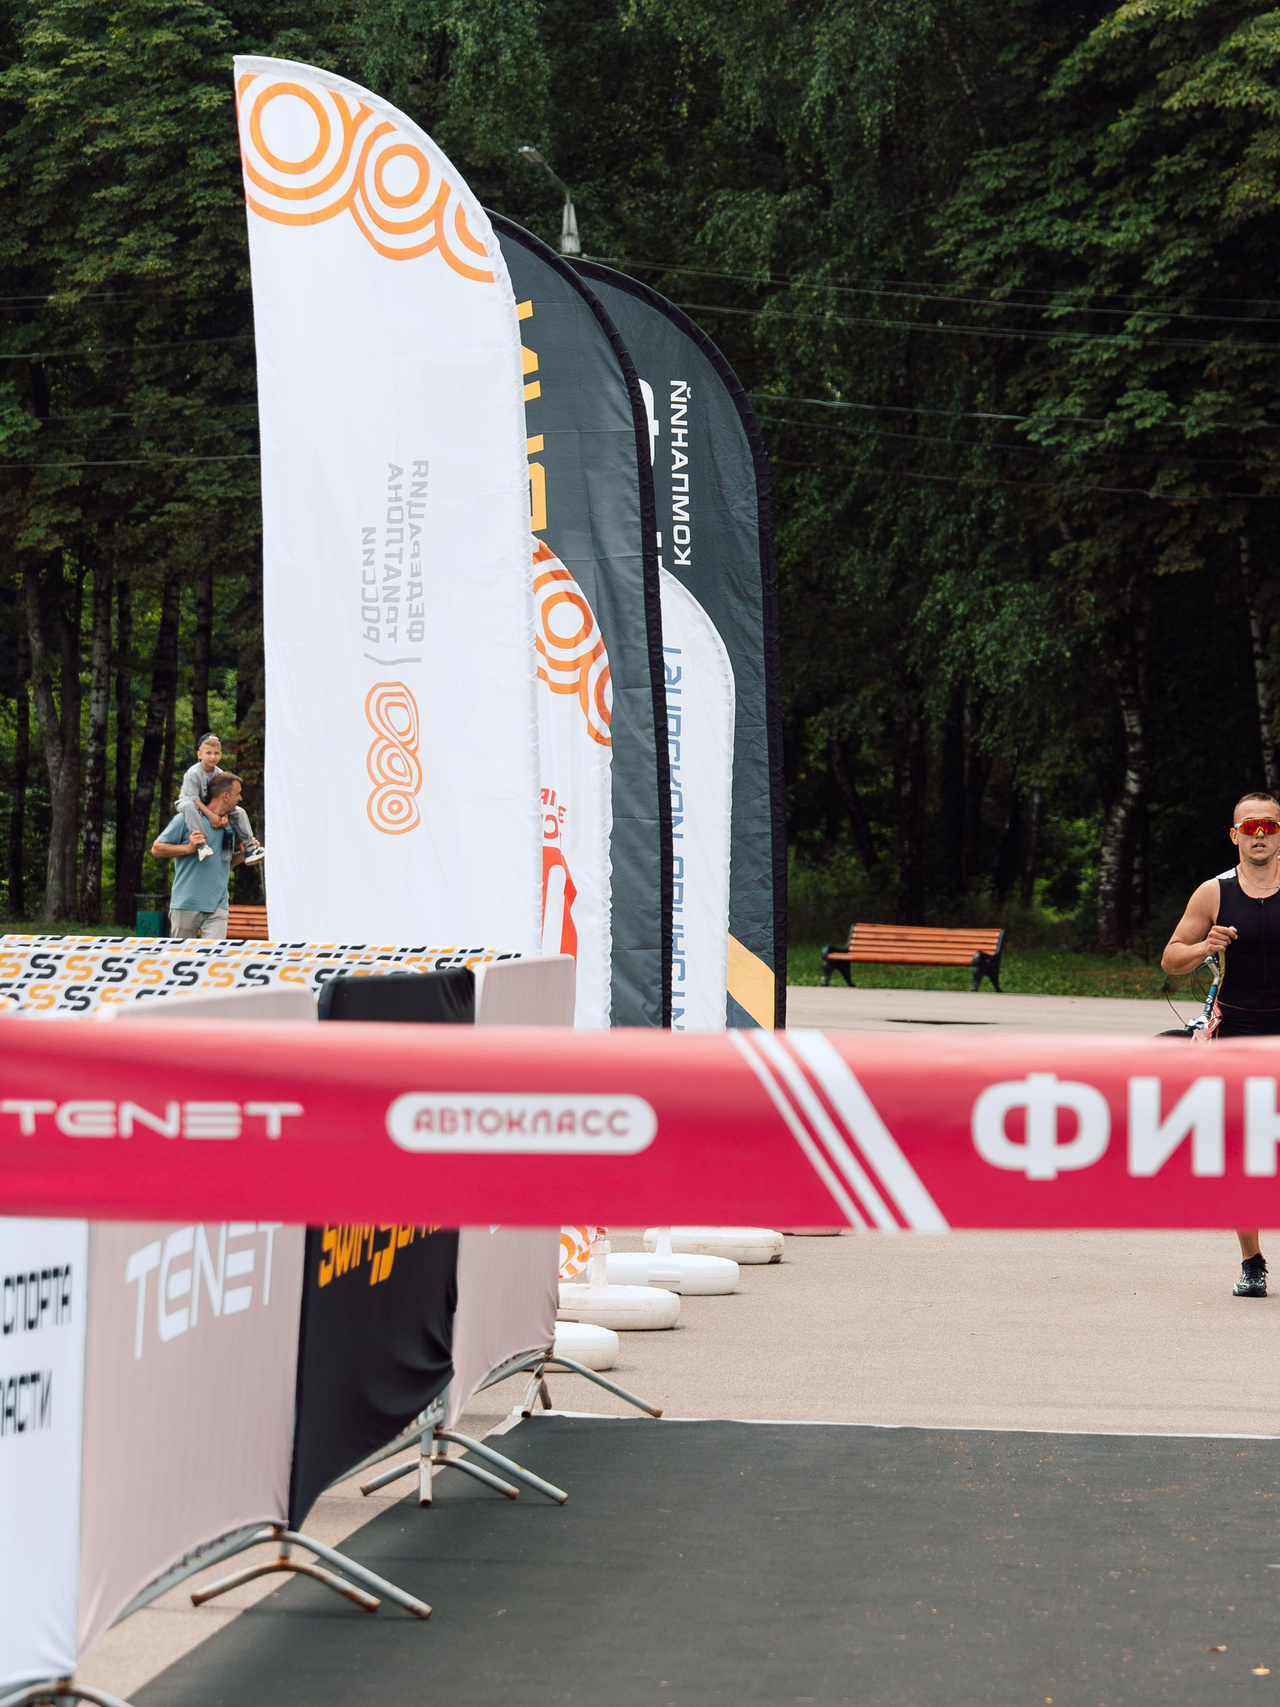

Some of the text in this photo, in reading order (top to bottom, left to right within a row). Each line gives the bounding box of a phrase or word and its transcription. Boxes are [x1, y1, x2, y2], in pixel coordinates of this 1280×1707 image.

[0, 1101, 304, 1139] TENET
[412, 1106, 631, 1138] АВТОКЛАСС
[125, 1222, 284, 1361] TENET
